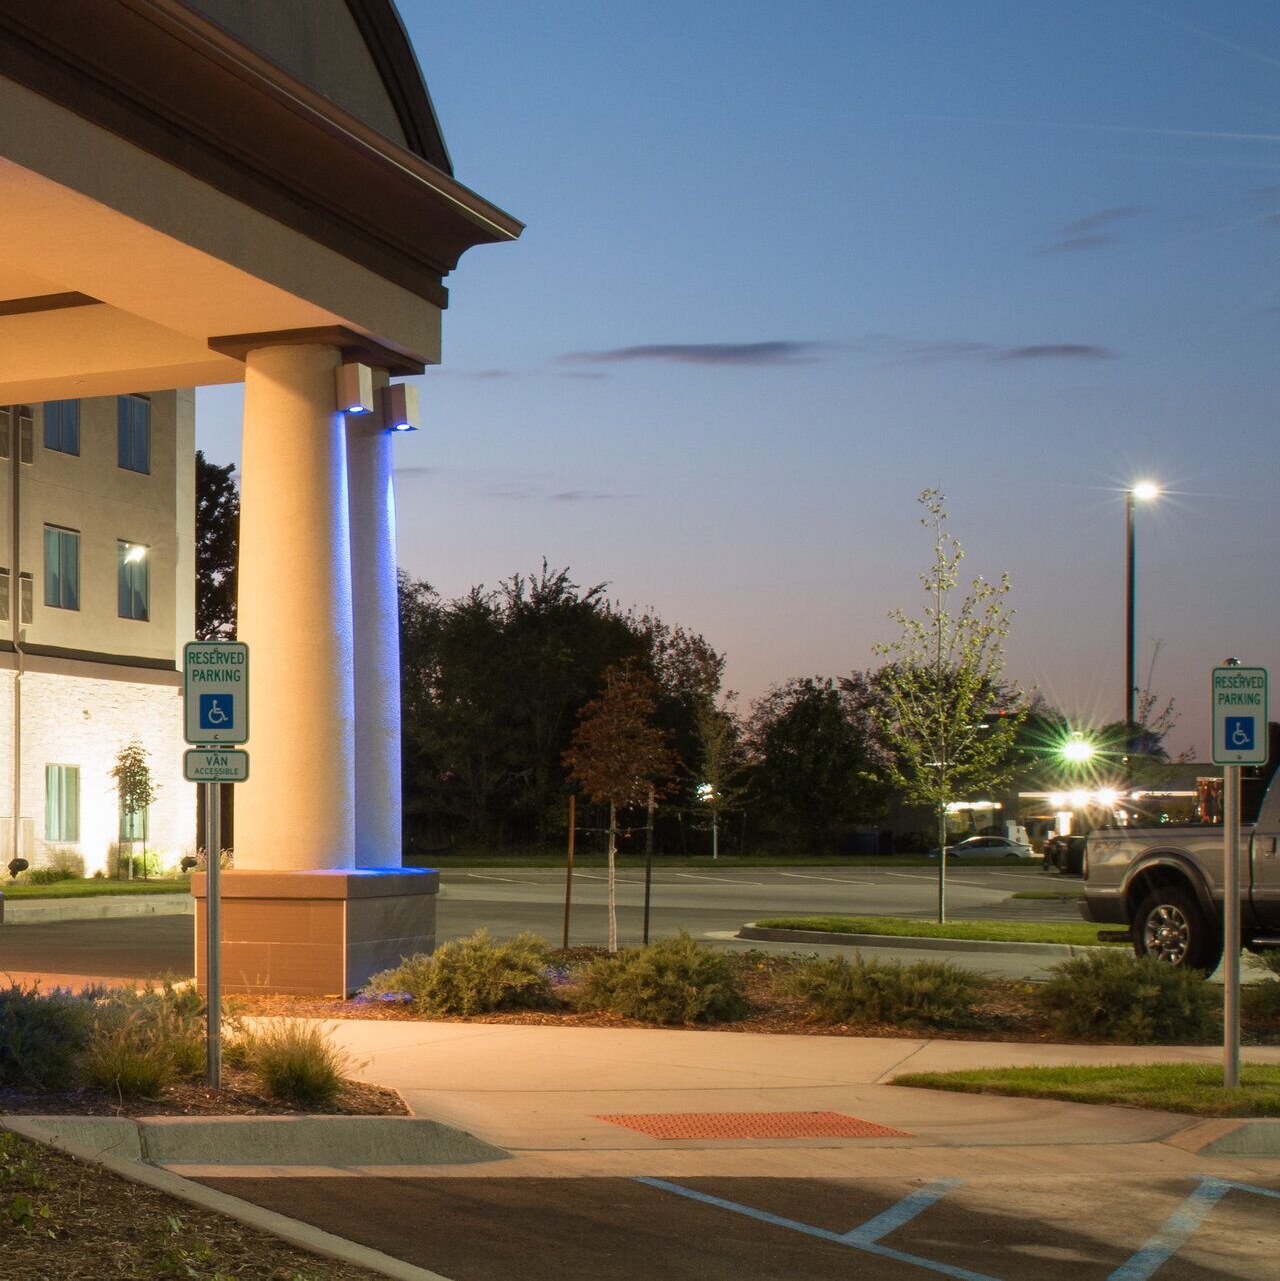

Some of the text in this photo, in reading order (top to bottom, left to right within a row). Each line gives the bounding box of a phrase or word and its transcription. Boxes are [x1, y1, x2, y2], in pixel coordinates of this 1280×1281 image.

[188, 651, 245, 665] RESERVED
[192, 669, 241, 682] PARKING
[1215, 676, 1264, 689] RESERVED
[1218, 693, 1261, 705] PARKING
[206, 756, 228, 766] VAN
